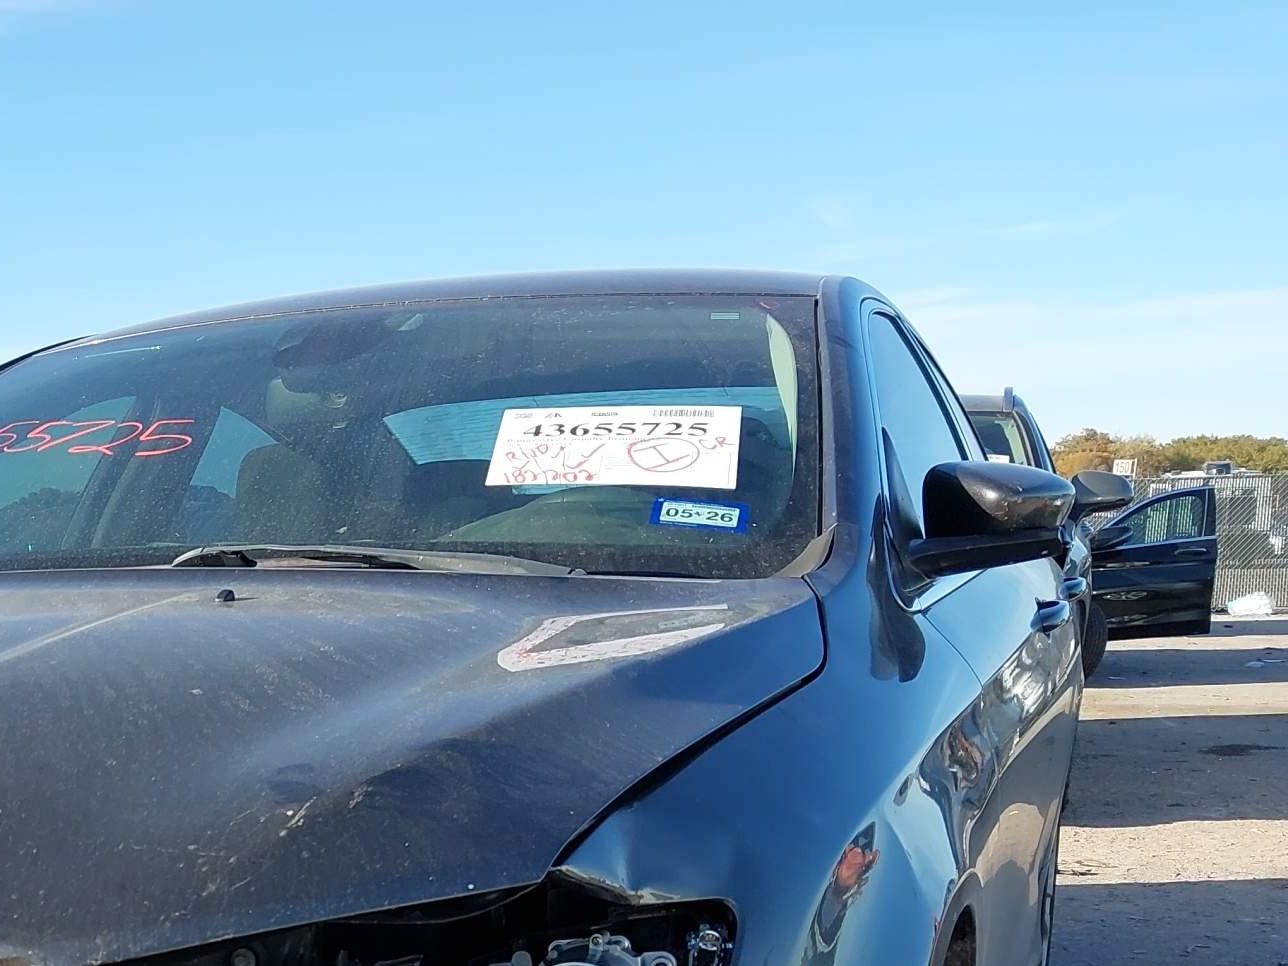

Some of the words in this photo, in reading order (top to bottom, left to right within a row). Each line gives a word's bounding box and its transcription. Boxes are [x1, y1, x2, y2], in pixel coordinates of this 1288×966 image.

[523, 422, 709, 437] 43655725
[1116, 461, 1130, 473] 150
[665, 507, 693, 519] 05
[706, 511, 735, 523] 26
